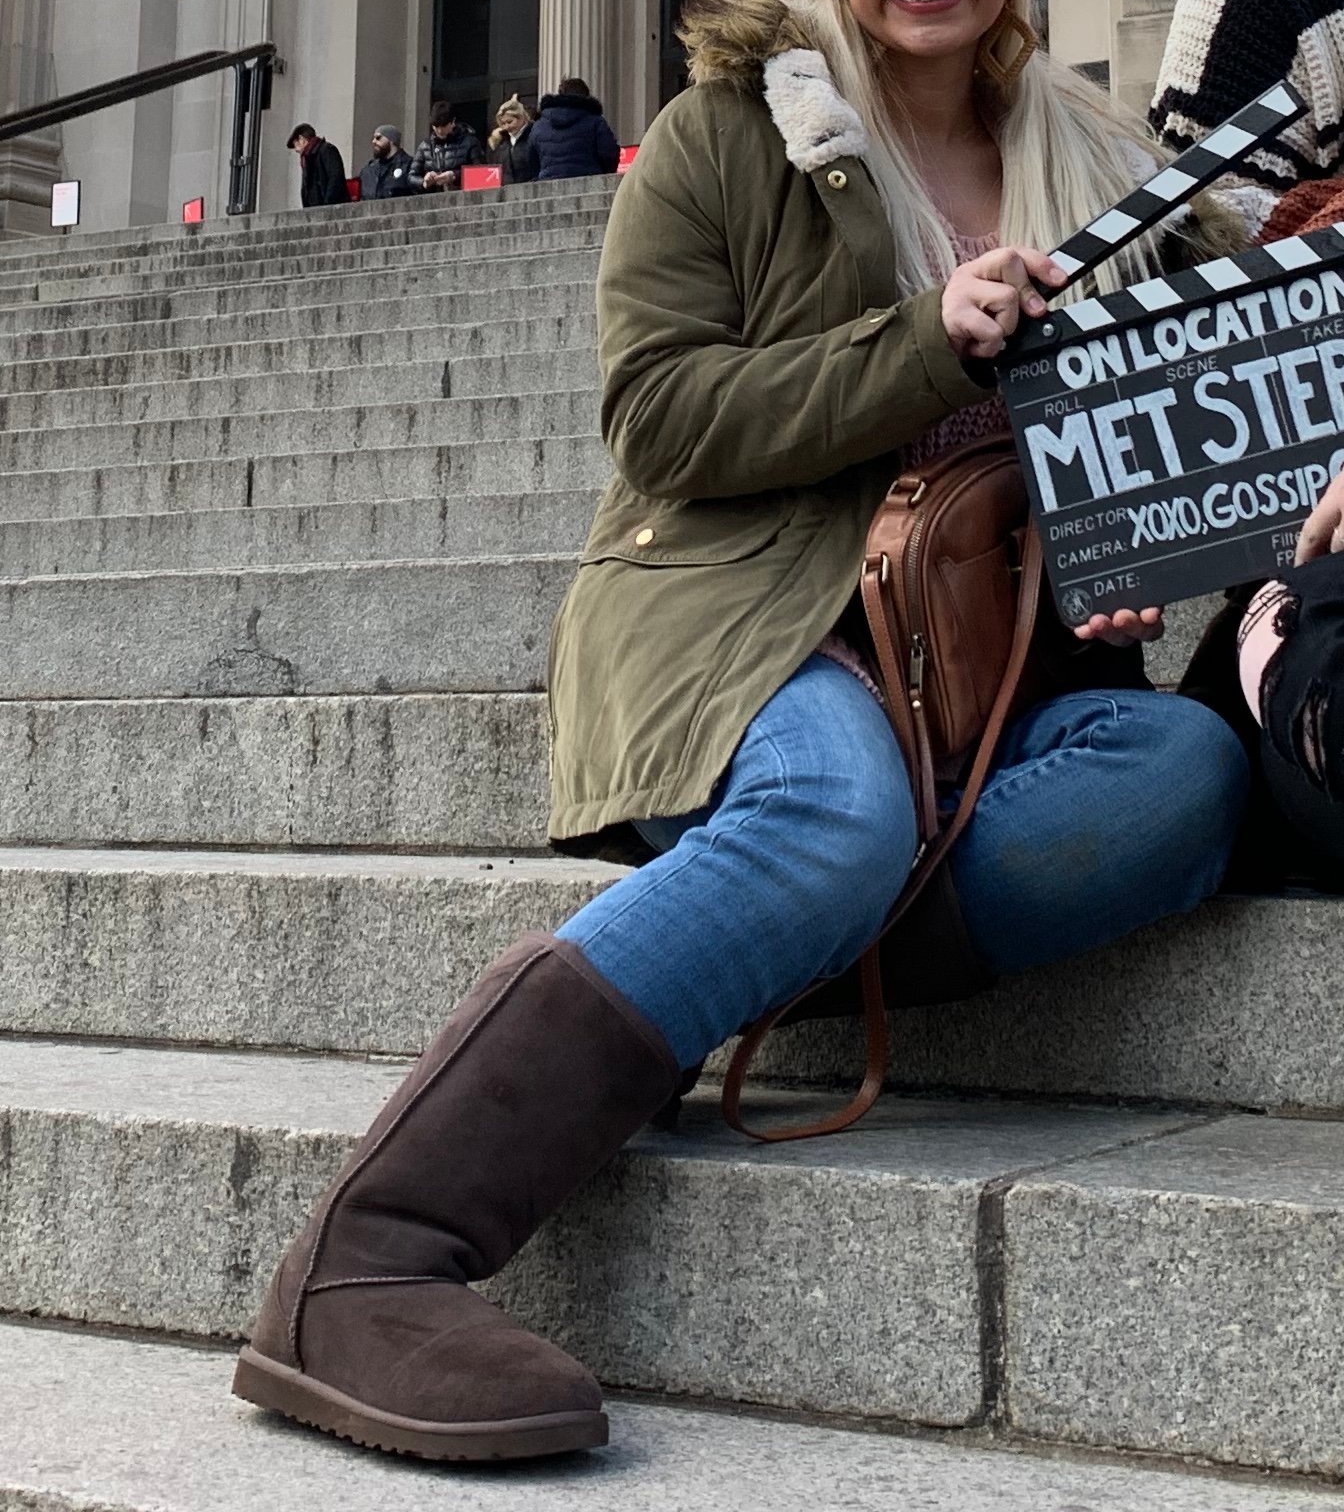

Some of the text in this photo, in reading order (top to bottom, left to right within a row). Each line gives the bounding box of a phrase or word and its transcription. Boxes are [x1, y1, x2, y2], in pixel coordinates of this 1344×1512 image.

[1301, 318, 1344, 343] TAKE
[1010, 359, 1054, 383] PROD.
[1056, 334, 1128, 390] ON
[1165, 355, 1218, 383] SCENE
[1044, 395, 1084, 418] ROLL
[1024, 387, 1185, 513] MET
[1127, 496, 1209, 549] XOXO,
[1202, 464, 1329, 529] GOSSIP
[1056, 539, 1129, 569] CAMERA:
[1094, 572, 1141, 597] DATE:
